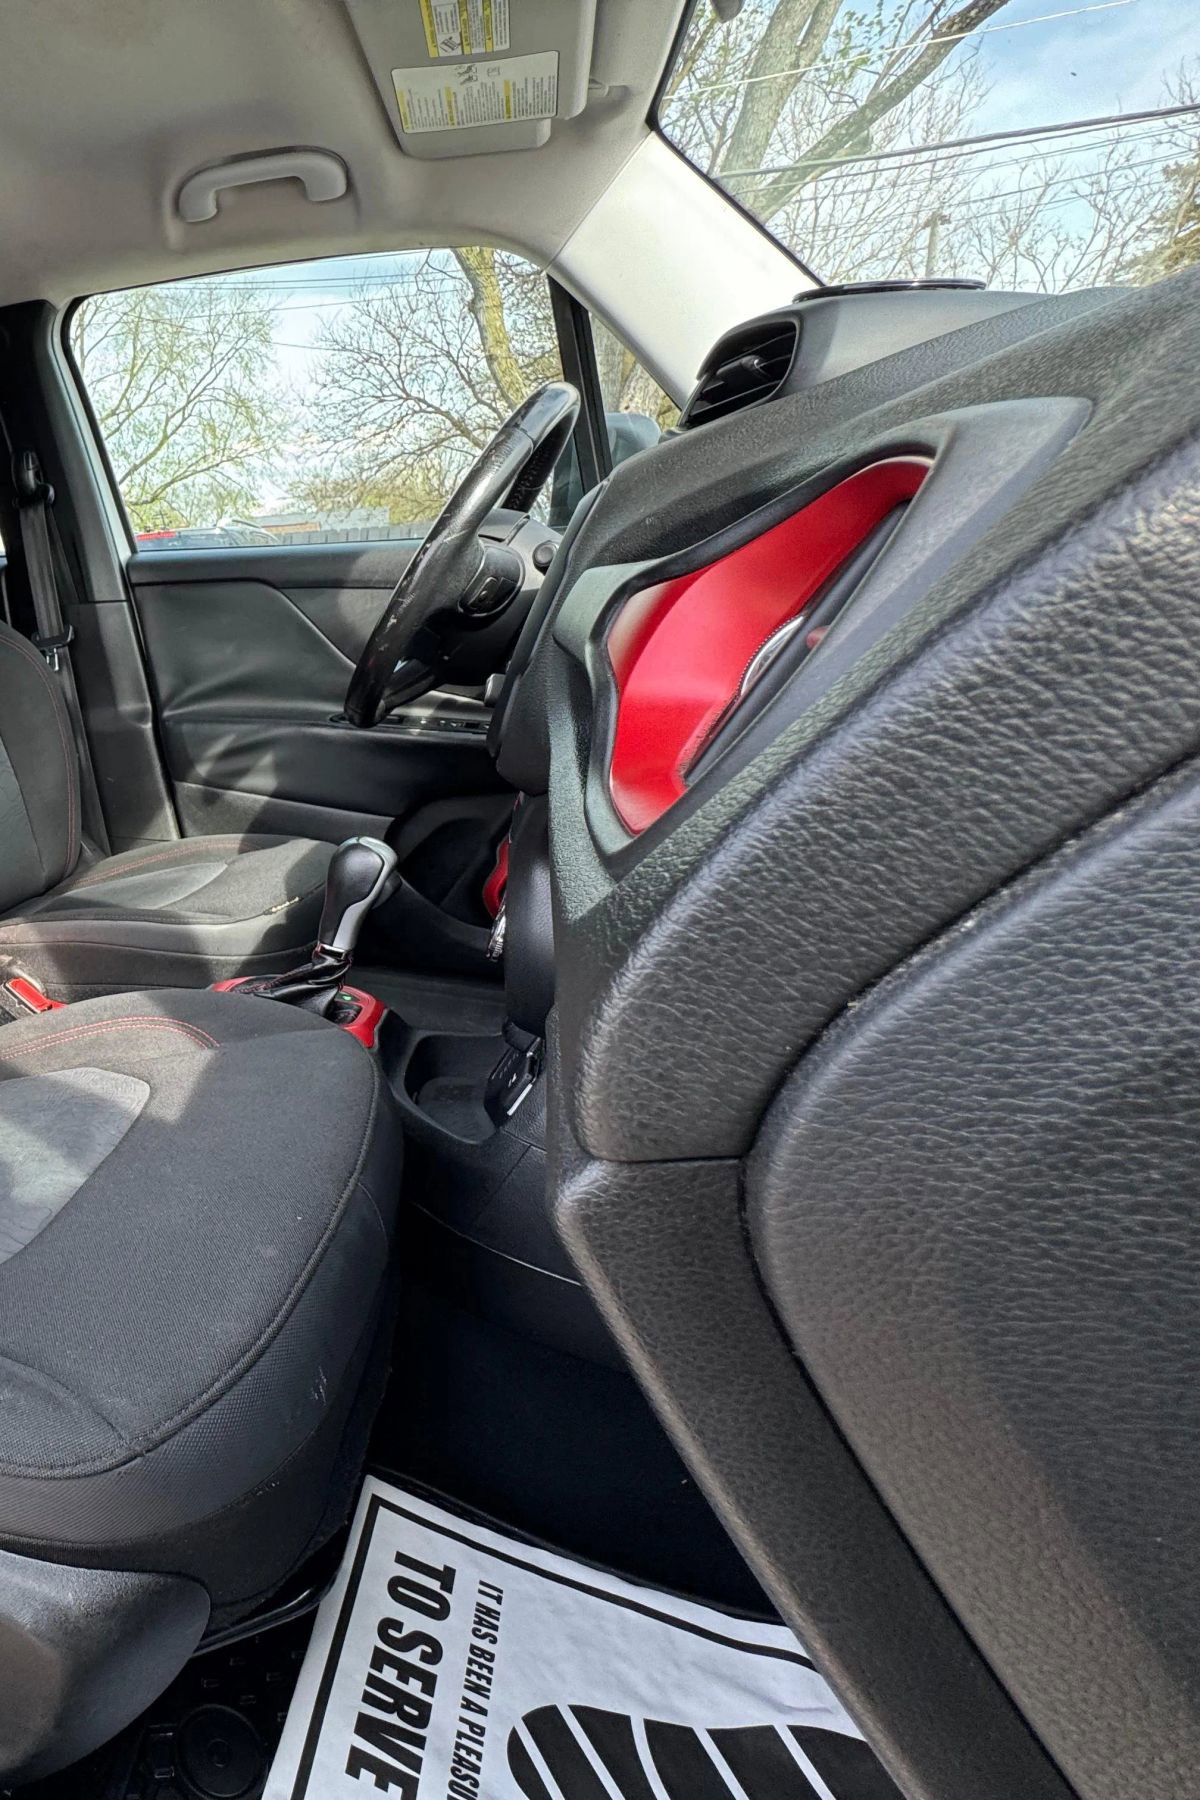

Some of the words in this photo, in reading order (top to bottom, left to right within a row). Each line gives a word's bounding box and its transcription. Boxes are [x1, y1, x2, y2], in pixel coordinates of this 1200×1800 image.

[387, 1550, 457, 1622] TO
[477, 1580, 504, 1606] IT
[471, 1601, 501, 1645] HAS
[463, 1643, 497, 1700] BEEN
[345, 1617, 444, 1800] SERVE
[460, 1696, 488, 1718] A
[447, 1716, 487, 1800] PLEASU
